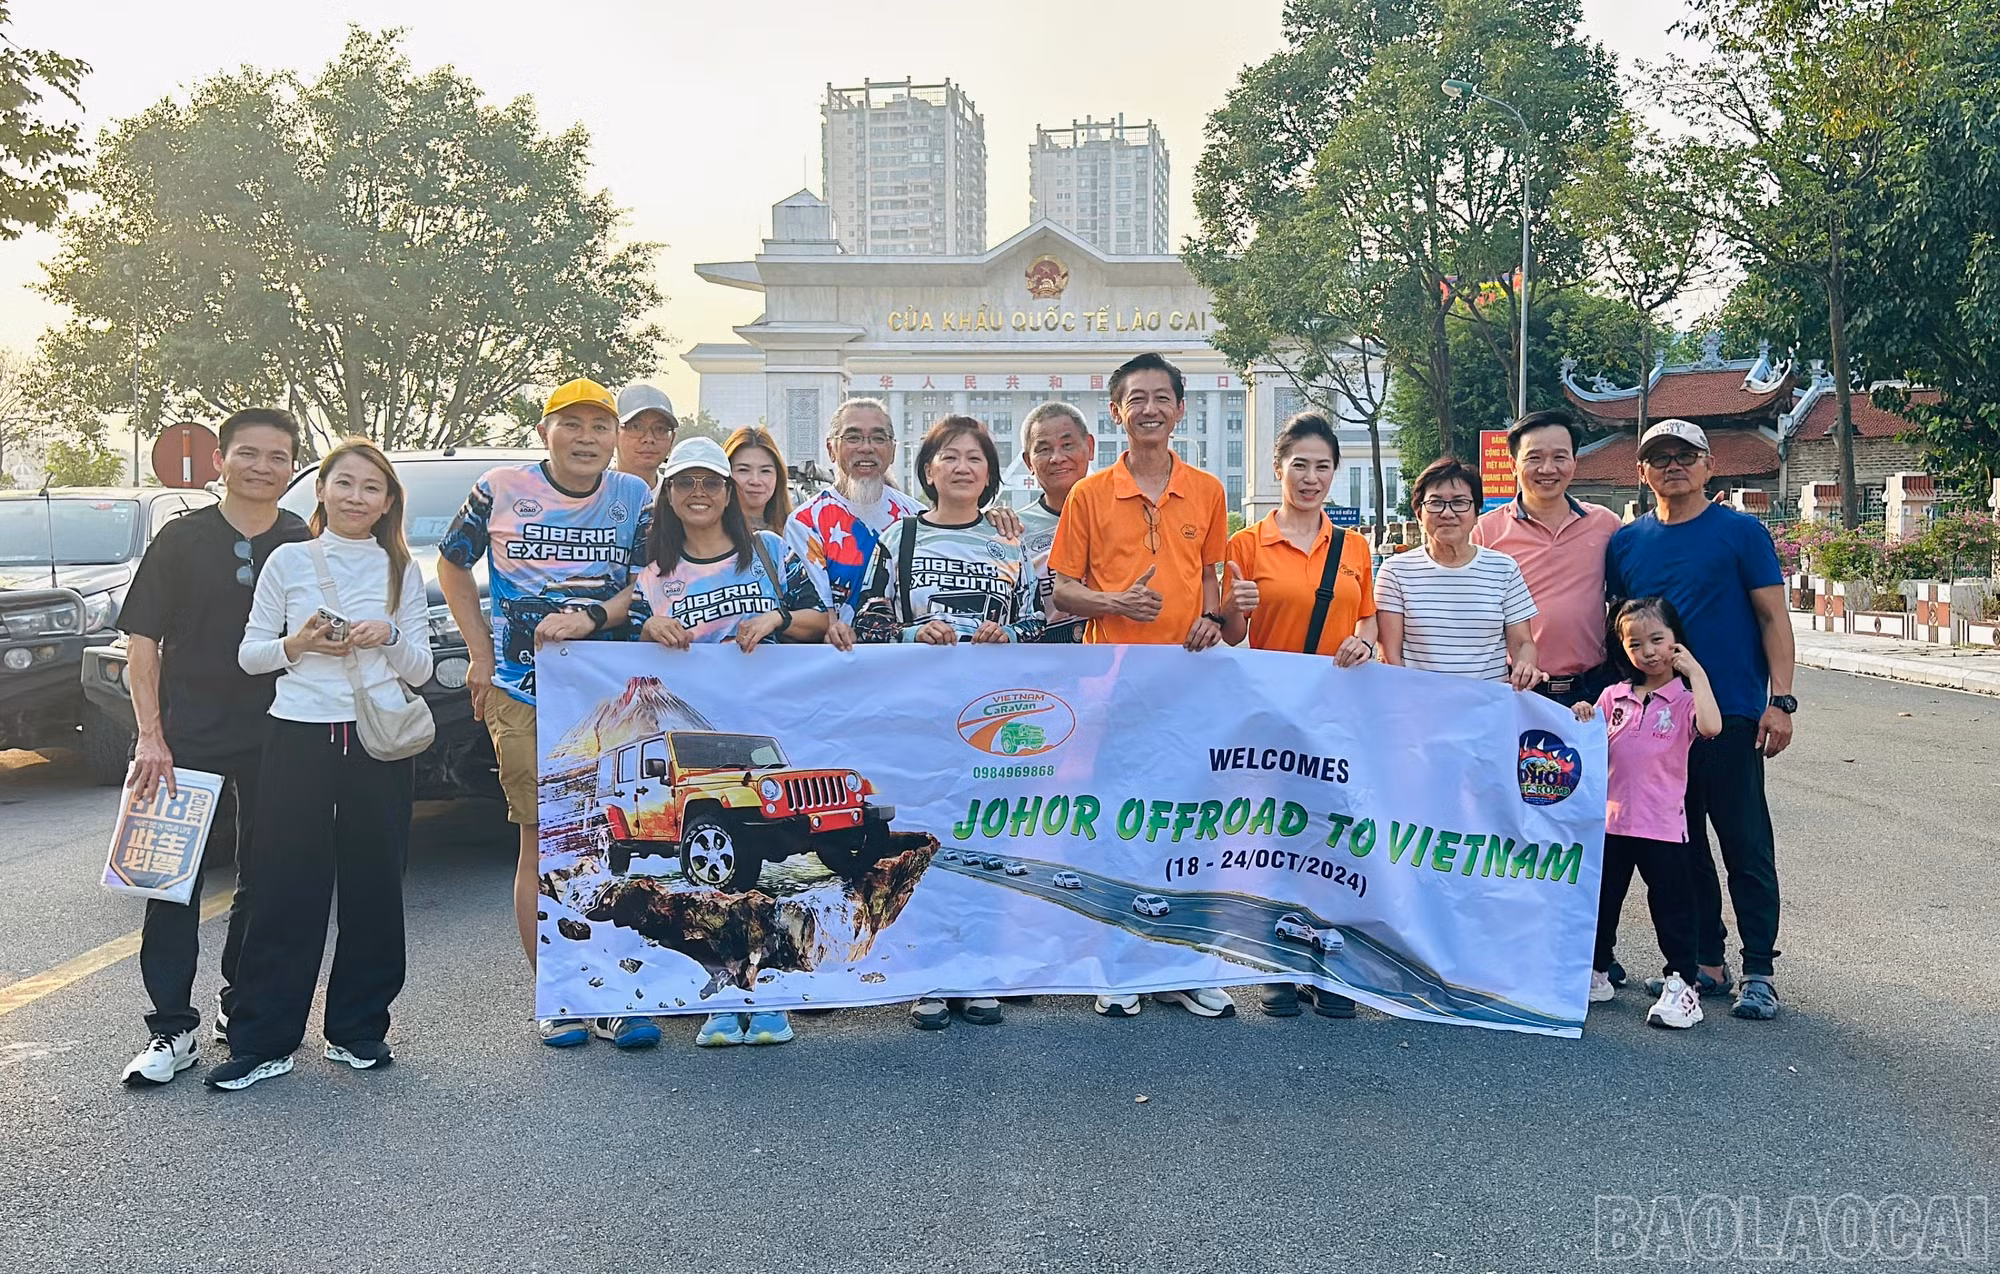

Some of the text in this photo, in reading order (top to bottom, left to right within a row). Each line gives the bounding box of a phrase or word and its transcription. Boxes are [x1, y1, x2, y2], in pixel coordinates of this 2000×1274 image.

[941, 302, 1004, 332] KHẨU
[1011, 305, 1076, 332] QUỐC
[1083, 304, 1109, 332] TẾ
[1117, 307, 1161, 332] LÀO
[1169, 310, 1206, 332] CAI
[524, 524, 616, 544] SIBERIA
[911, 557, 999, 577] SIBERIA
[673, 581, 762, 614] SIBERIA
[674, 597, 775, 629] XPEDITIO
[992, 693, 1045, 702] VIETNAM
[973, 765, 1055, 778] 0984969868
[1209, 748, 1349, 783] WELCOMES
[187, 792, 209, 824] ROUTE
[952, 794, 1584, 884] JOHOR OFFROAD TO VIETNAM
[1165, 856, 1199, 882] (18
[1221, 849, 1367, 897] 24/OCT/2024)
